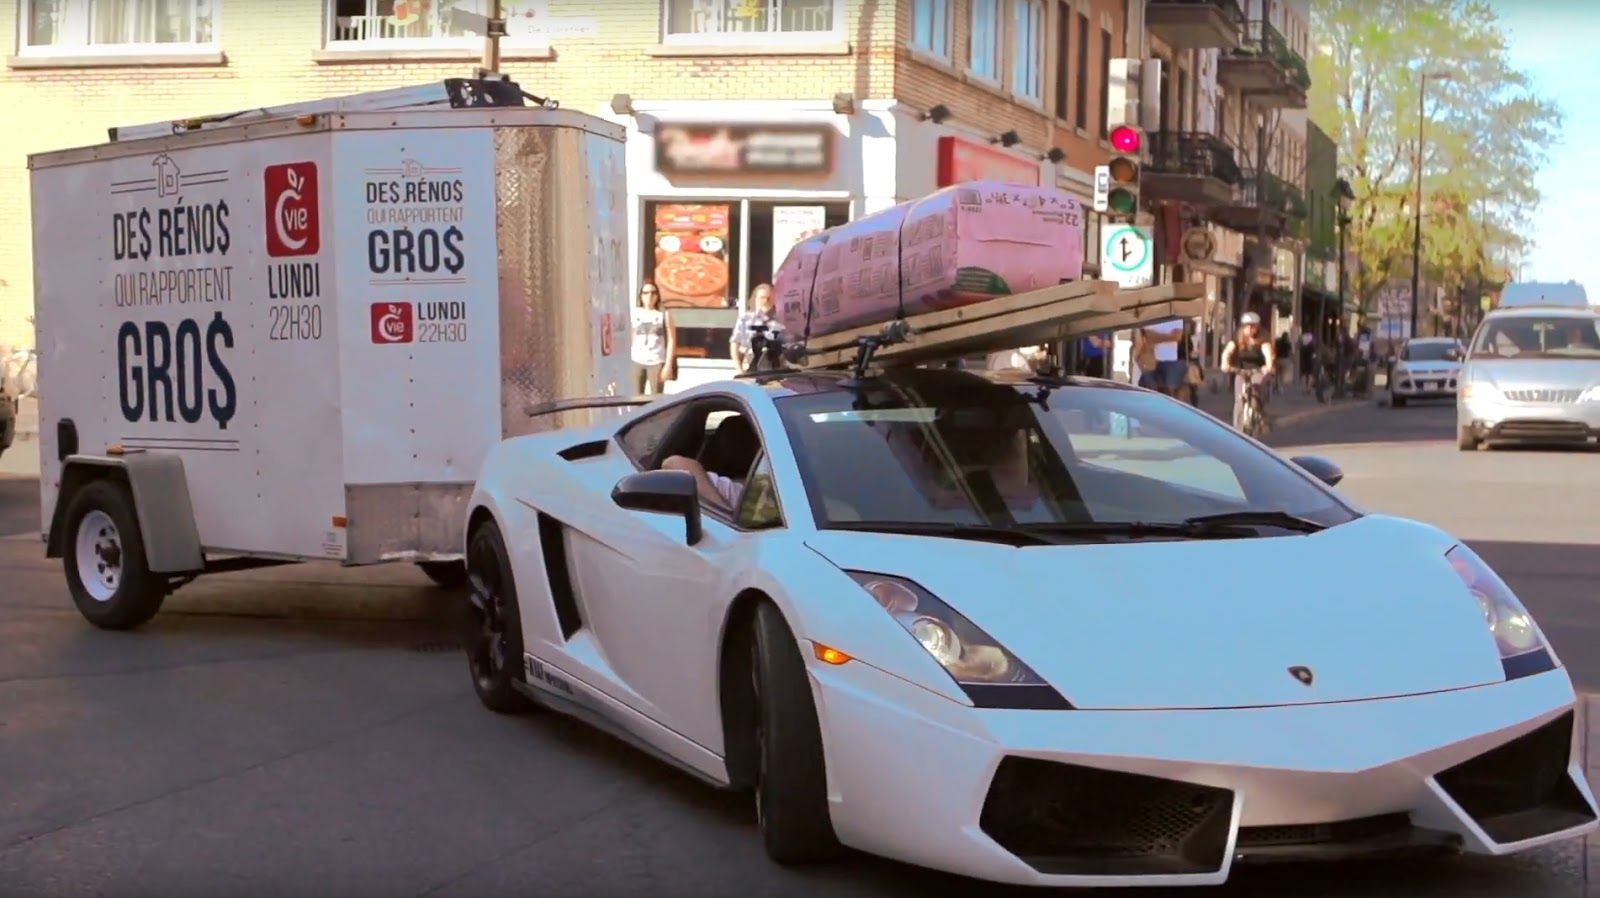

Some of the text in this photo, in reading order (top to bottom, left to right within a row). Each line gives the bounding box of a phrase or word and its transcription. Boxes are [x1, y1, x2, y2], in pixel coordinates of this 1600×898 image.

[367, 205, 464, 225] QUI RAPPORTENT
[115, 266, 234, 307] QUI RAPPORTENT
[268, 262, 321, 299] LUNDI
[269, 304, 322, 341] 22H30
[418, 301, 466, 321] LUNDI
[418, 323, 467, 343] 22H30
